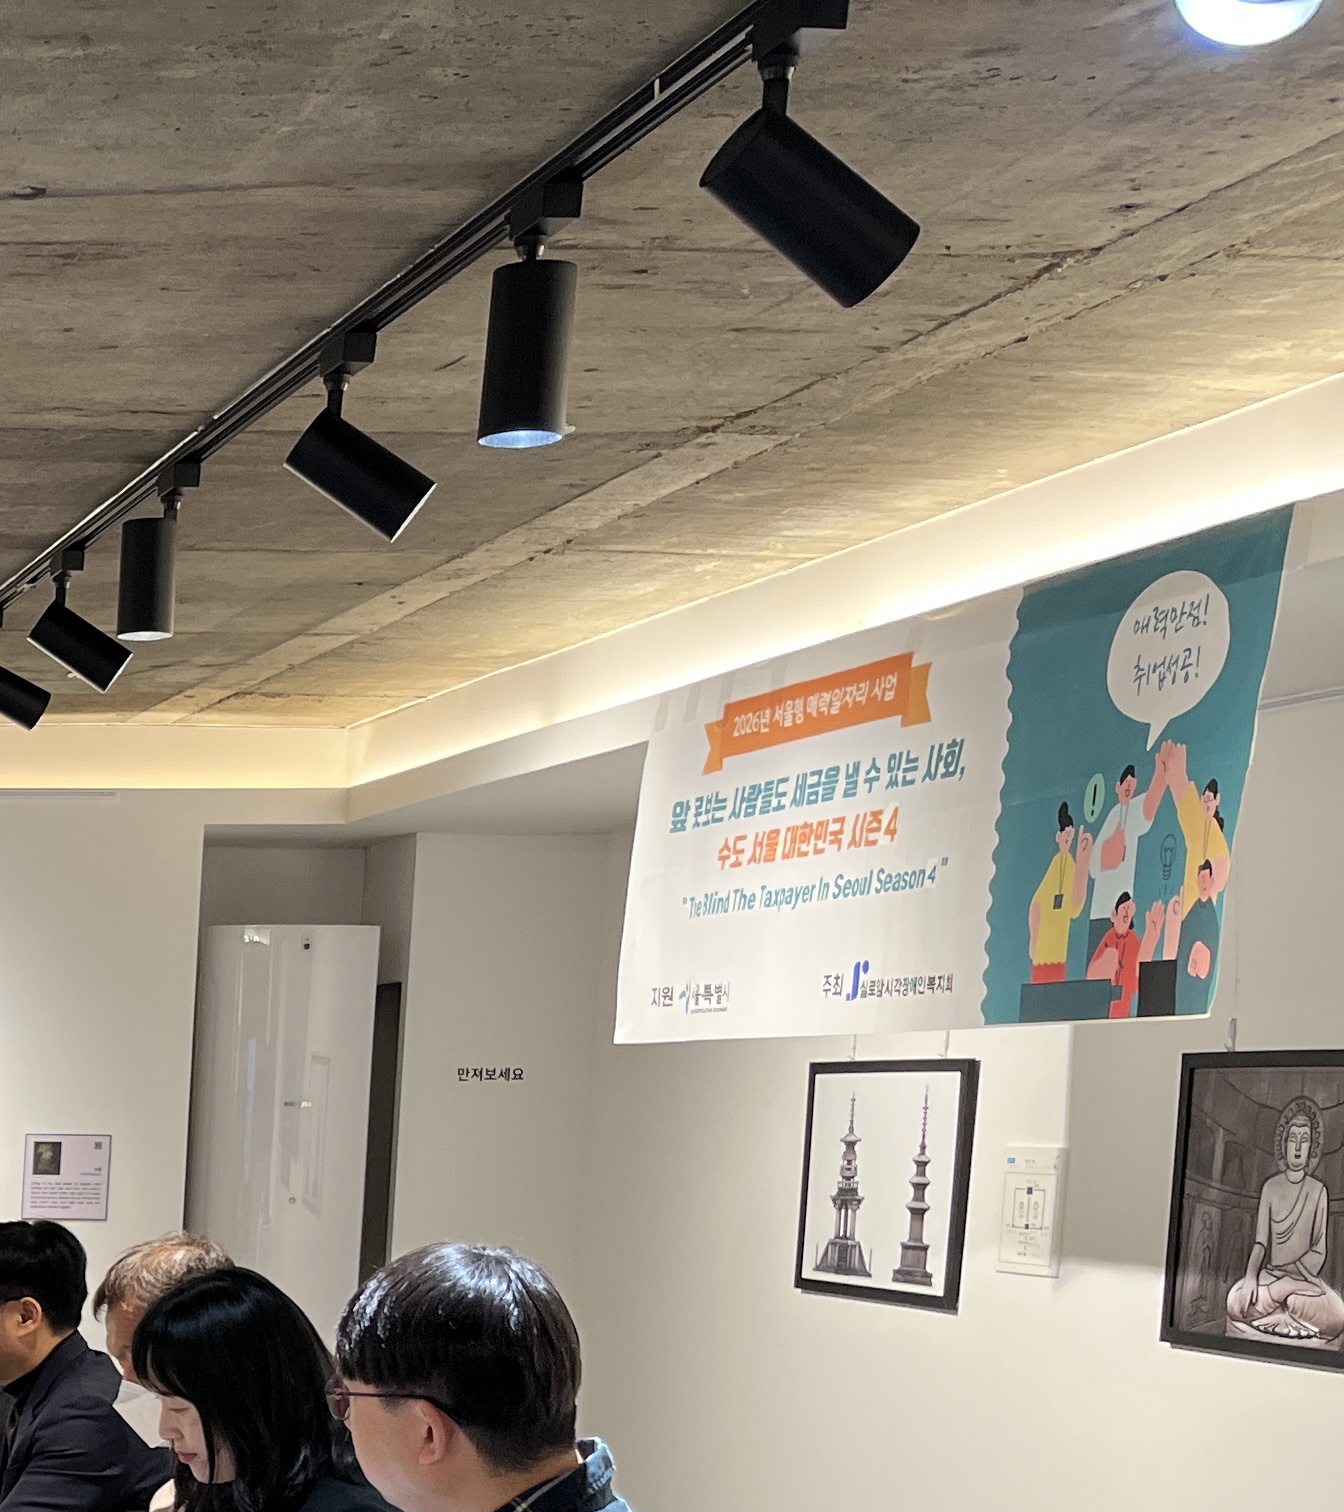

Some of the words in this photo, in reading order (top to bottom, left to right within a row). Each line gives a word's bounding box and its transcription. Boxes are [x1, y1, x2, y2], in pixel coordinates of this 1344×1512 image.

[1133, 593, 1210, 640] 매력만점!
[1133, 645, 1201, 696] 취업성공!
[732, 706, 771, 737] 2026년
[772, 699, 804, 728] 서울형
[806, 680, 870, 718] 매력일자리
[870, 672, 898, 702] 사업
[669, 799, 691, 834] 앞
[728, 776, 790, 822] 사람들도
[790, 766, 841, 809] 세금을
[842, 760, 861, 799] 낼
[863, 757, 881, 794] 수
[885, 749, 920, 791] 있는
[921, 737, 966, 783] 사회,
[717, 833, 748, 871] 수도
[746, 828, 781, 866] 서울
[781, 815, 847, 861] 대한민국
[731, 888, 757, 912] The
[759, 884, 817, 913] Taxpayer
[816, 876, 830, 902] In
[832, 869, 874, 900] Seoul
[874, 867, 927, 895] Season
[650, 984, 674, 1008] 지원
[822, 973, 845, 998] 주최
[457, 1066, 524, 1082] 만져보세요
